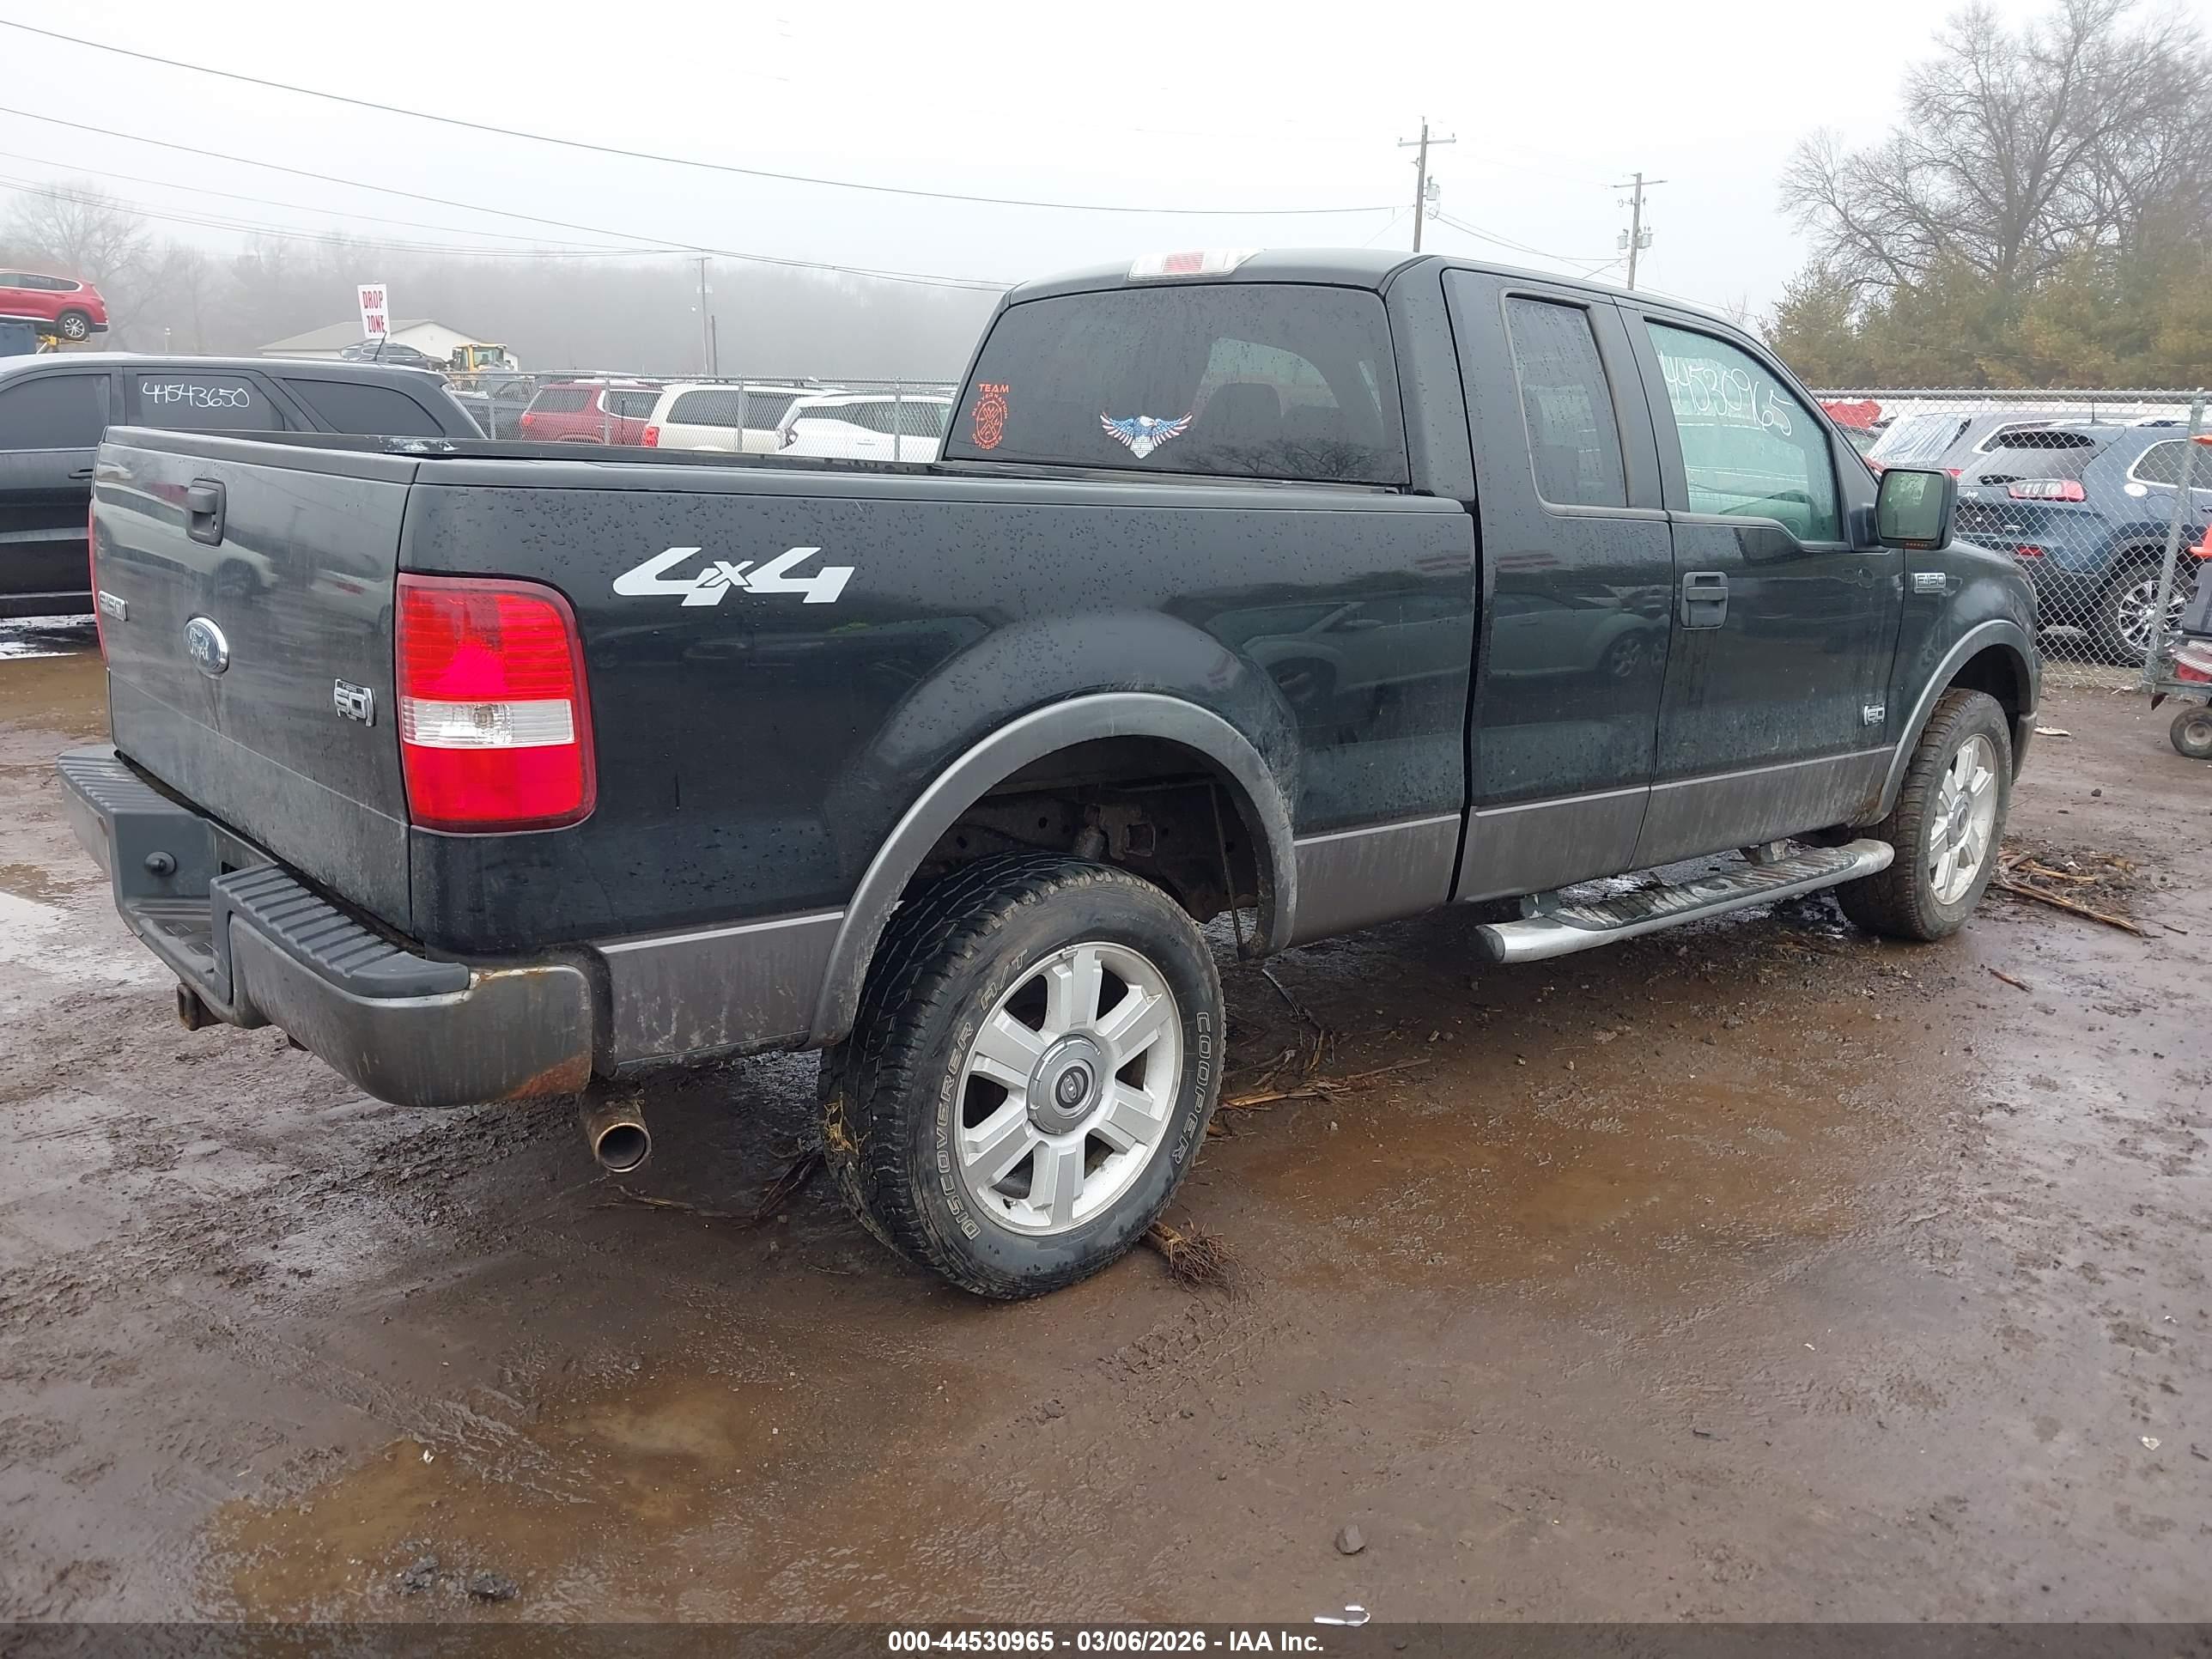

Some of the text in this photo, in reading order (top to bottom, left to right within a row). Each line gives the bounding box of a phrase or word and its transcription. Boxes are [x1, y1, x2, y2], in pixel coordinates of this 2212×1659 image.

[362, 290, 383, 309] DROP
[367, 314, 386, 333] ZONE
[143, 382, 250, 408] 44543650
[979, 384, 1010, 393] TEAM
[1658, 349, 1795, 437] 44530965
[981, 949, 1028, 1011] A/T
[1172, 1012, 1212, 1164] COOPER
[936, 1022, 981, 1240] DISCOVERER
